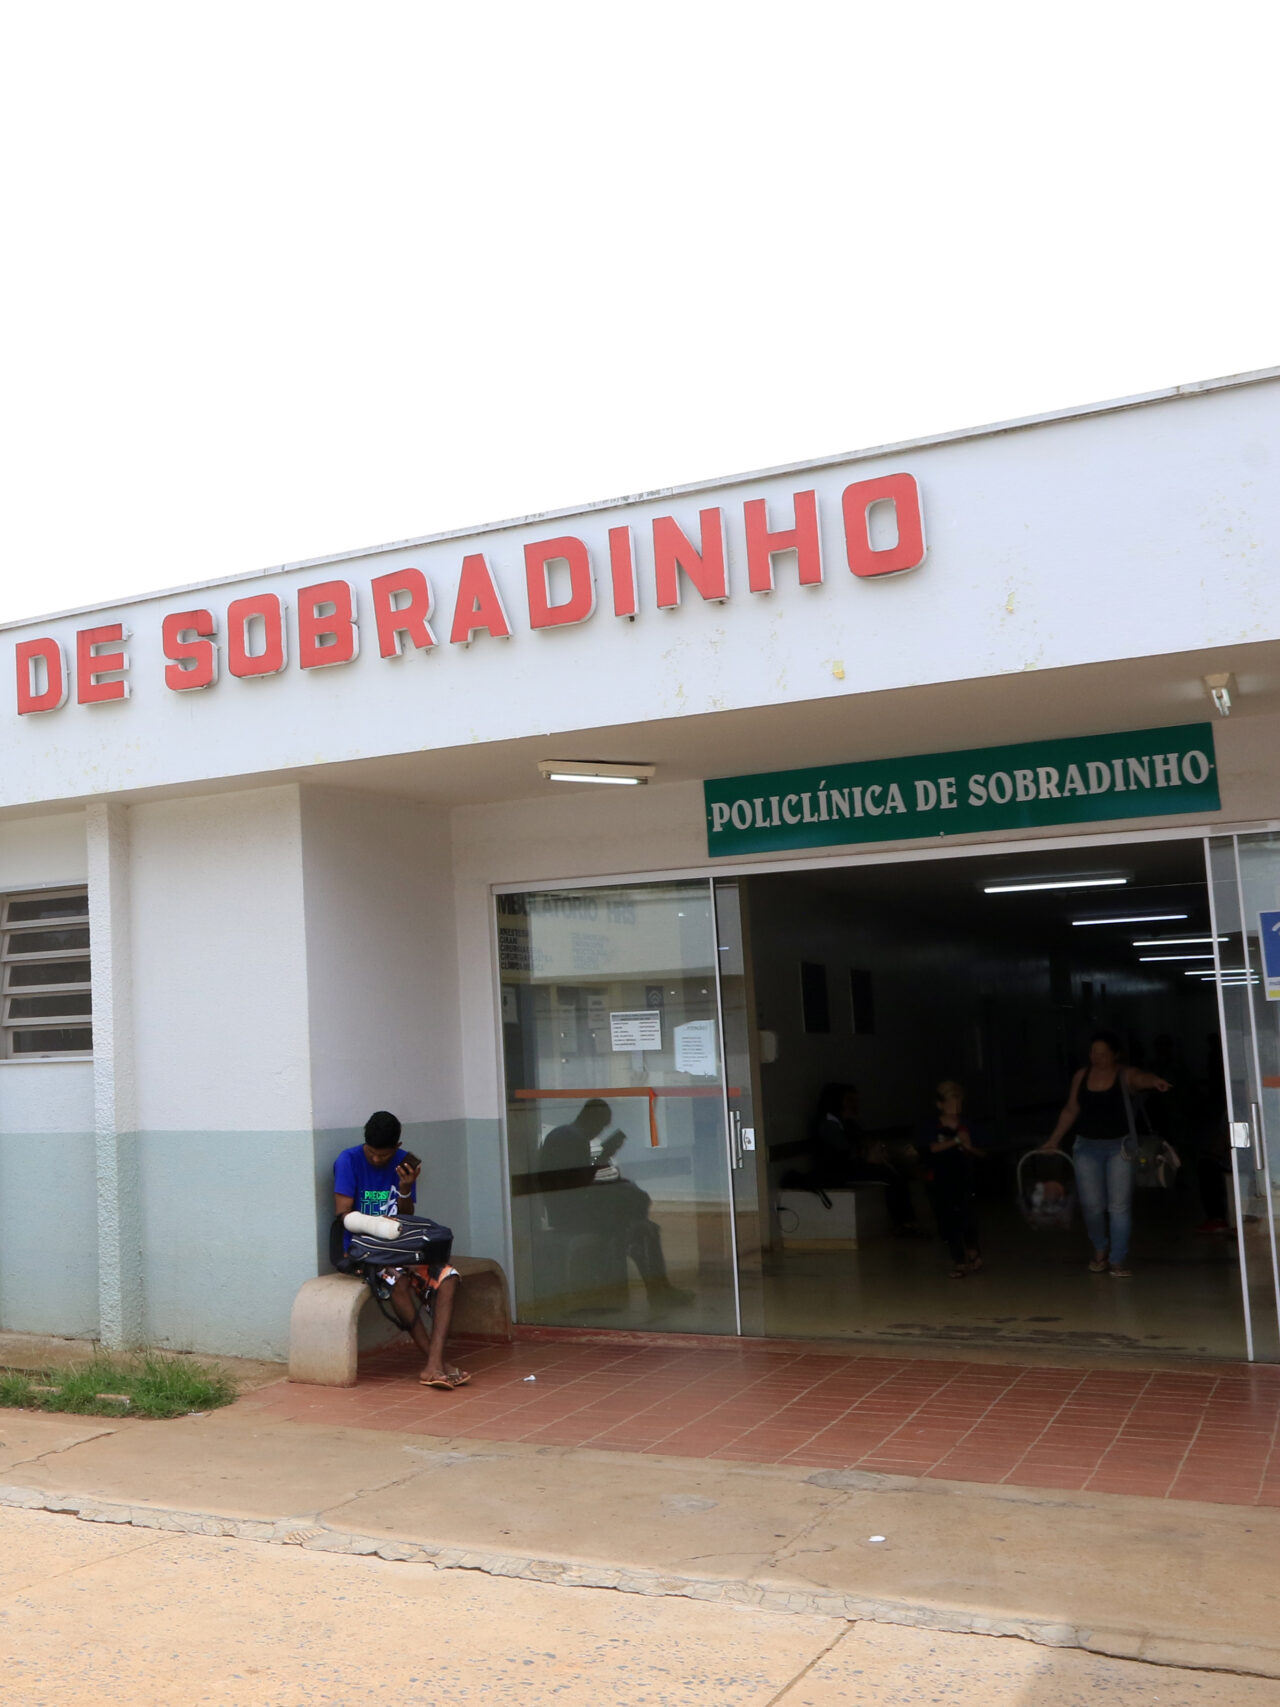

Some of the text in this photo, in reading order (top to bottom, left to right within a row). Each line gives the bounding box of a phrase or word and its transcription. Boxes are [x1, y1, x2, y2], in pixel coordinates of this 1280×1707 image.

[16, 624, 128, 715] DE
[162, 472, 926, 693] SOBRADINHO
[711, 750, 1208, 832] POLICLÍNICA DE SOBRADINHO
